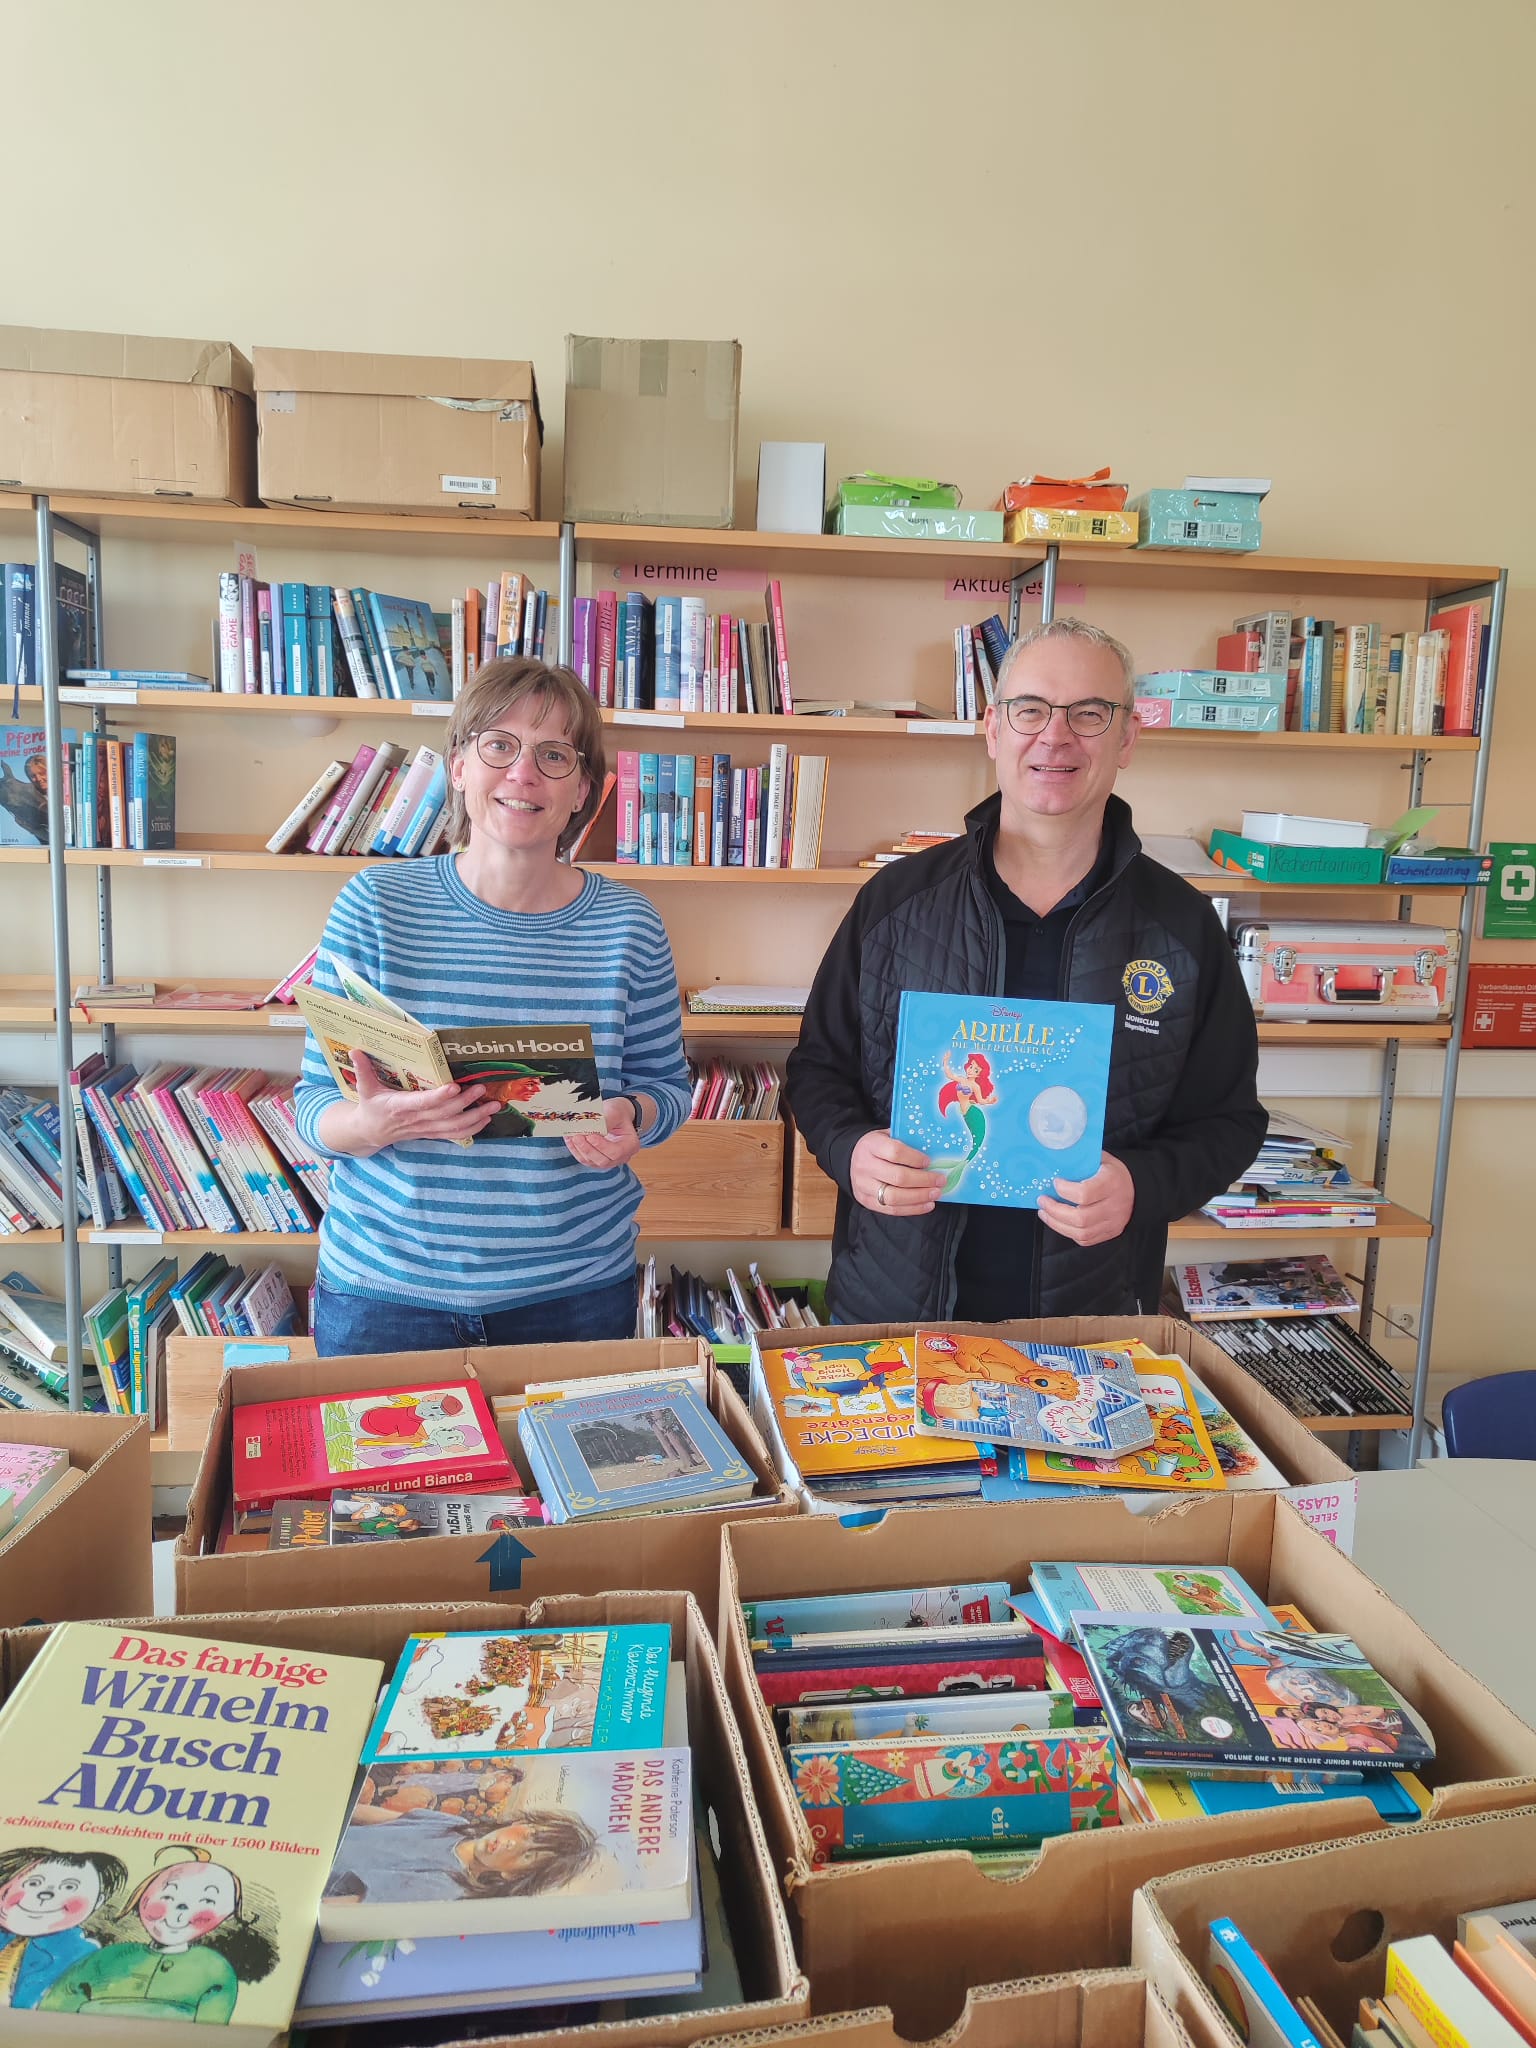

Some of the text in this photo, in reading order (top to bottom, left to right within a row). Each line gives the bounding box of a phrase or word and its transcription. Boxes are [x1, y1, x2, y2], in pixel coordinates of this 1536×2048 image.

[953, 578, 1046, 596] Aktuees
[229, 618, 238, 648] GAME
[599, 600, 613, 667] Roter Blitz
[625, 615, 637, 655] AMAL
[1271, 850, 1371, 881] Rechentraining
[1391, 863, 1470, 882] Rechentraining
[1128, 960, 1164, 974] LIONS
[1138, 975, 1153, 997] L
[988, 1003, 1023, 1020] Disney
[445, 1038, 585, 1056] Robin Hood
[951, 1019, 1055, 1047] ARIELLE
[806, 1414, 915, 1430] egensätze
[394, 1475, 421, 1491] und
[425, 1469, 474, 1488] Bianca
[1297, 1495, 1340, 1511] CLASS
[291, 1509, 329, 1545] Potter
[109, 1635, 328, 1688] Das farbige
[620, 1643, 645, 1724] Klassenzimmer
[637, 1646, 663, 1720] Das fliegende
[80, 1665, 330, 1733] Wilhelm
[82, 1715, 282, 1777] Busch
[857, 1739, 882, 1747] Wir
[1224, 1753, 1405, 1769] VOLUME ONE THE DELUXE JUNIOR NOVELIZATION
[38, 1762, 270, 1828] Album
[607, 1761, 640, 1835] MÄDCHEN
[637, 1759, 665, 1856] DAS ANDERE
[668, 1758, 681, 1839] Katherine Paterson
[3, 1815, 321, 1856] schönsten Geschichten mit über 1500 Bildern
